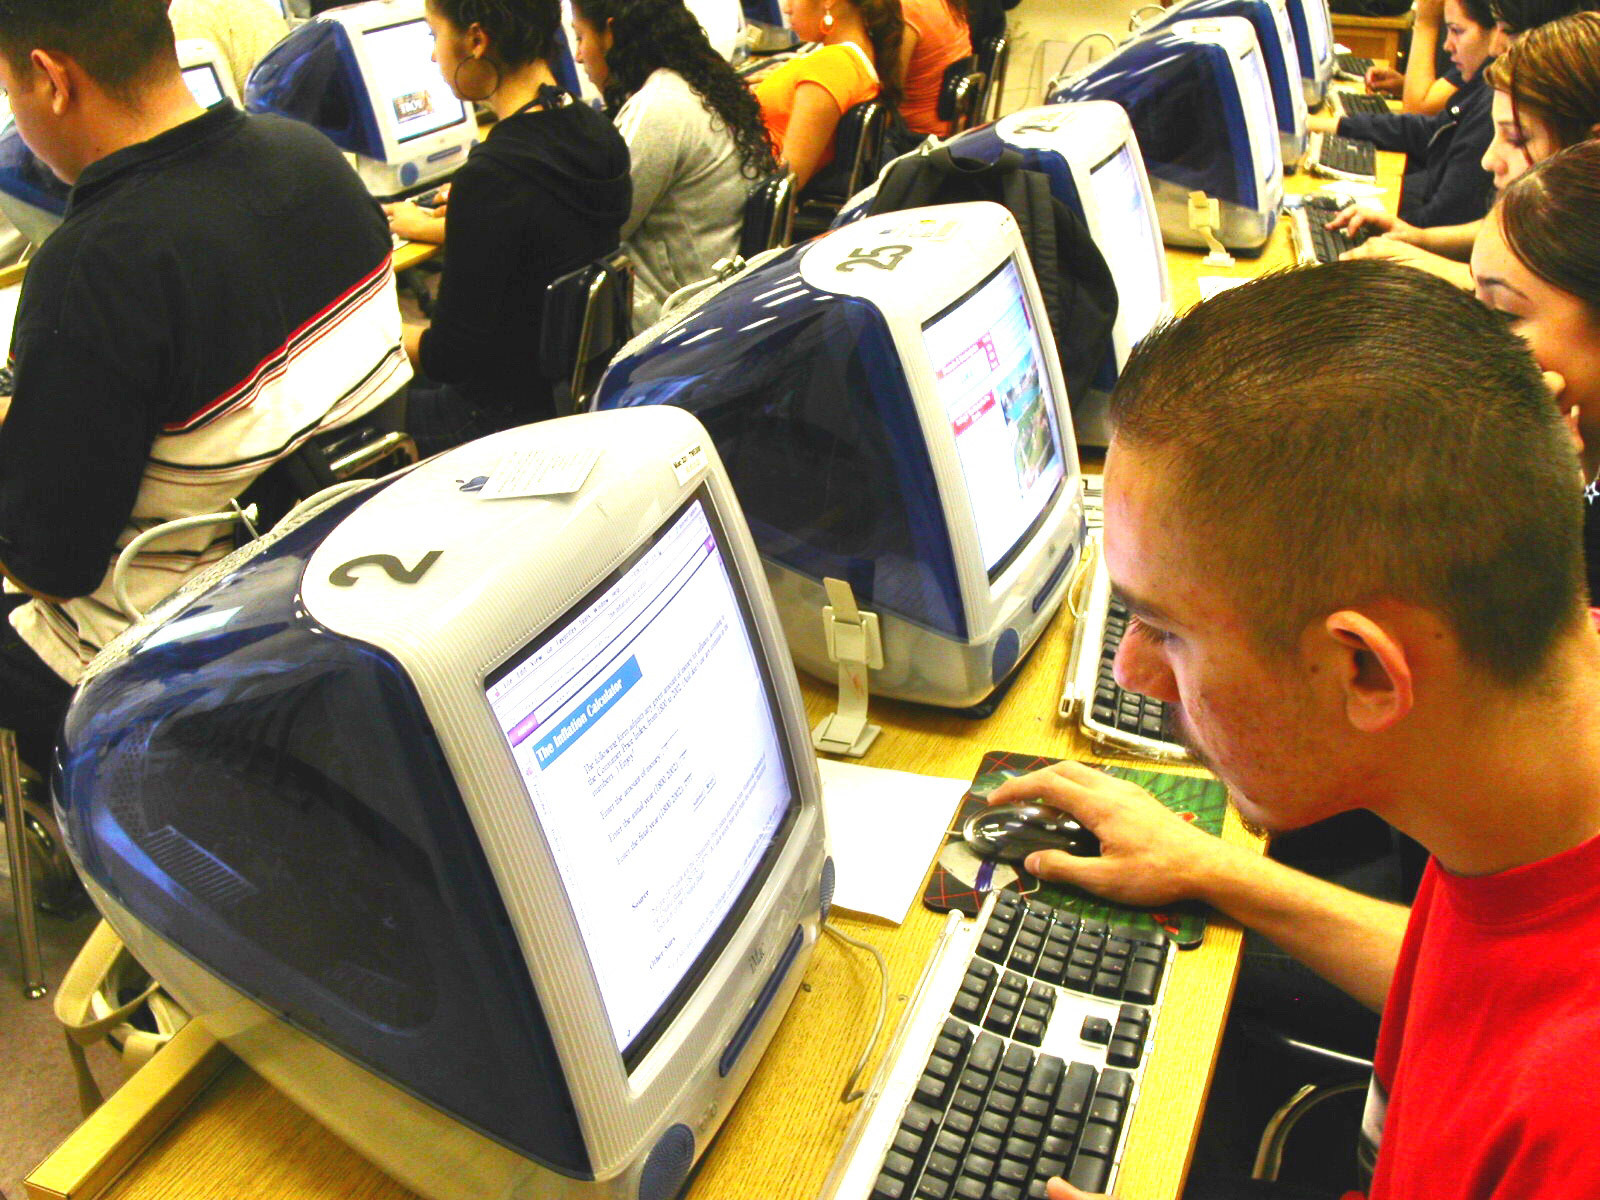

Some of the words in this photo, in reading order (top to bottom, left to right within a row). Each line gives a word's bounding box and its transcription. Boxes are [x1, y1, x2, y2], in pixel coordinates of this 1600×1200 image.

[836, 244, 912, 271] 25
[329, 550, 443, 586] 2
[535, 743, 555, 762] The
[552, 713, 588, 748] Inflation
[586, 679, 623, 718] Calculator
